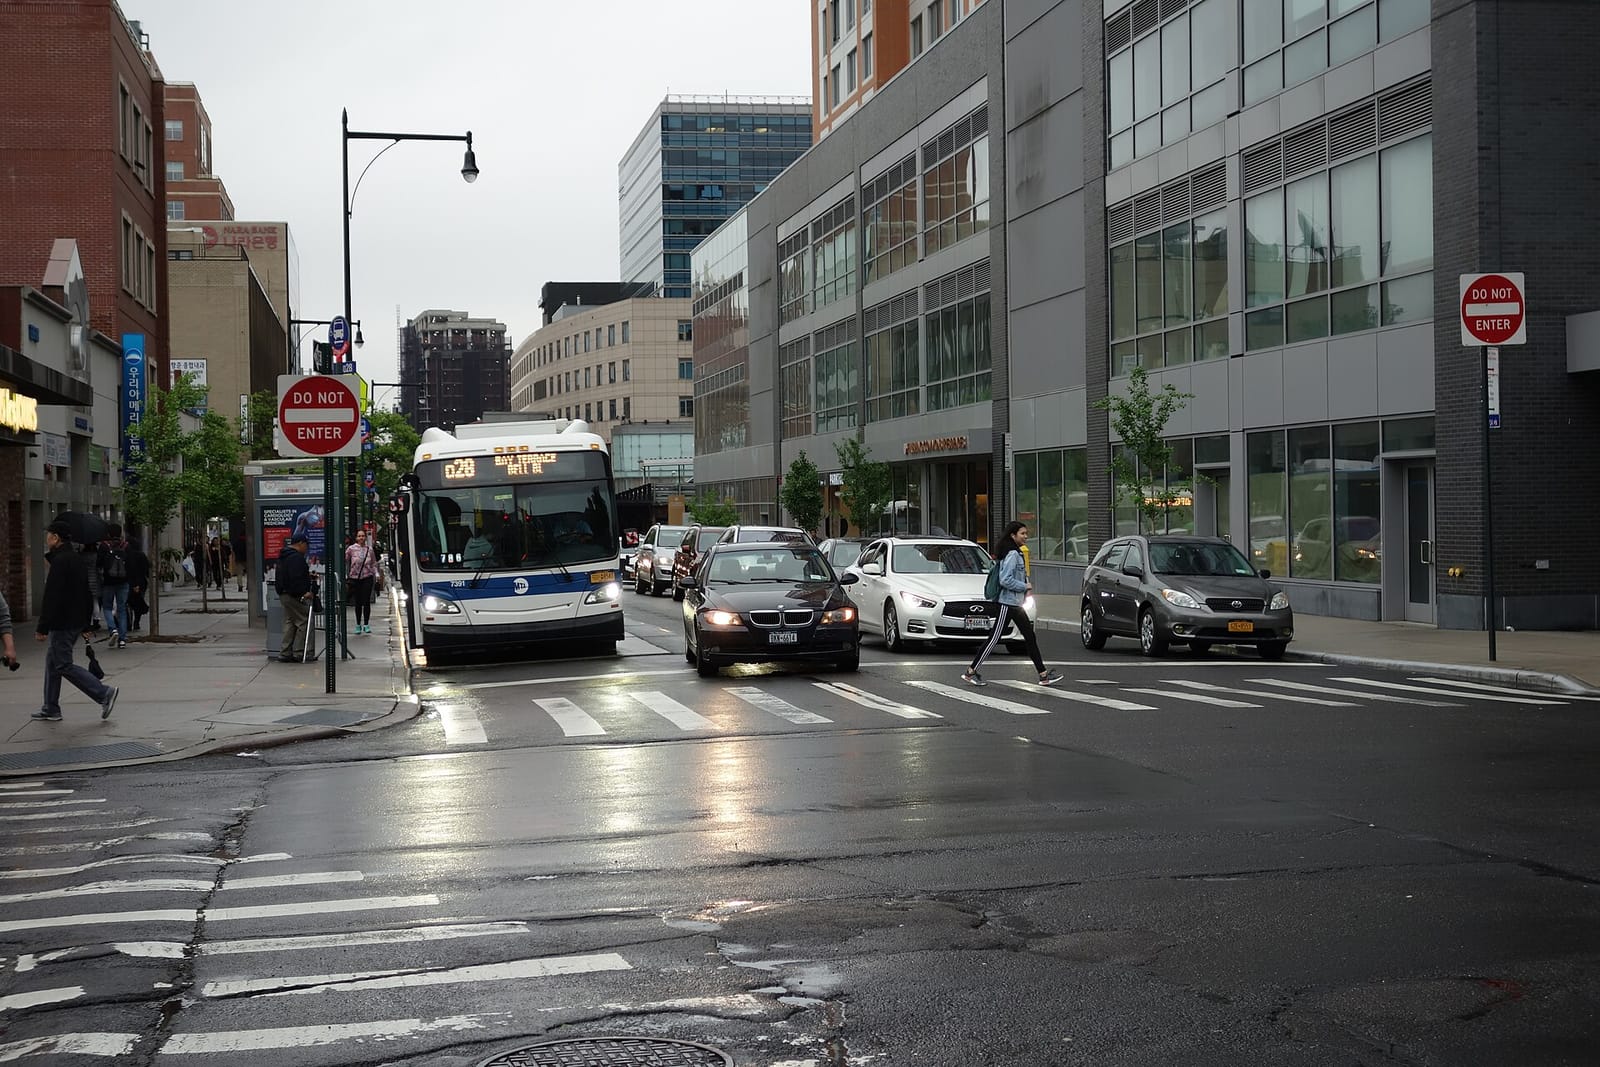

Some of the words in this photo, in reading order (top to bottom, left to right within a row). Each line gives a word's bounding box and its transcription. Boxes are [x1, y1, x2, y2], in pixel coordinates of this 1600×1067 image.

[1472, 288, 1487, 300] DO
[1491, 287, 1512, 299] NOT
[1475, 318, 1511, 331] ENTER
[293, 391, 312, 404] DO
[318, 391, 345, 404] NOT
[128, 366, 141, 458] 우리아메리은행
[297, 426, 342, 440] ENTER
[444, 458, 475, 479] Q28
[494, 455, 514, 466] BAY
[517, 453, 557, 464] TERRACE
[507, 463, 528, 475] BELL
[532, 462, 543, 474] BL
